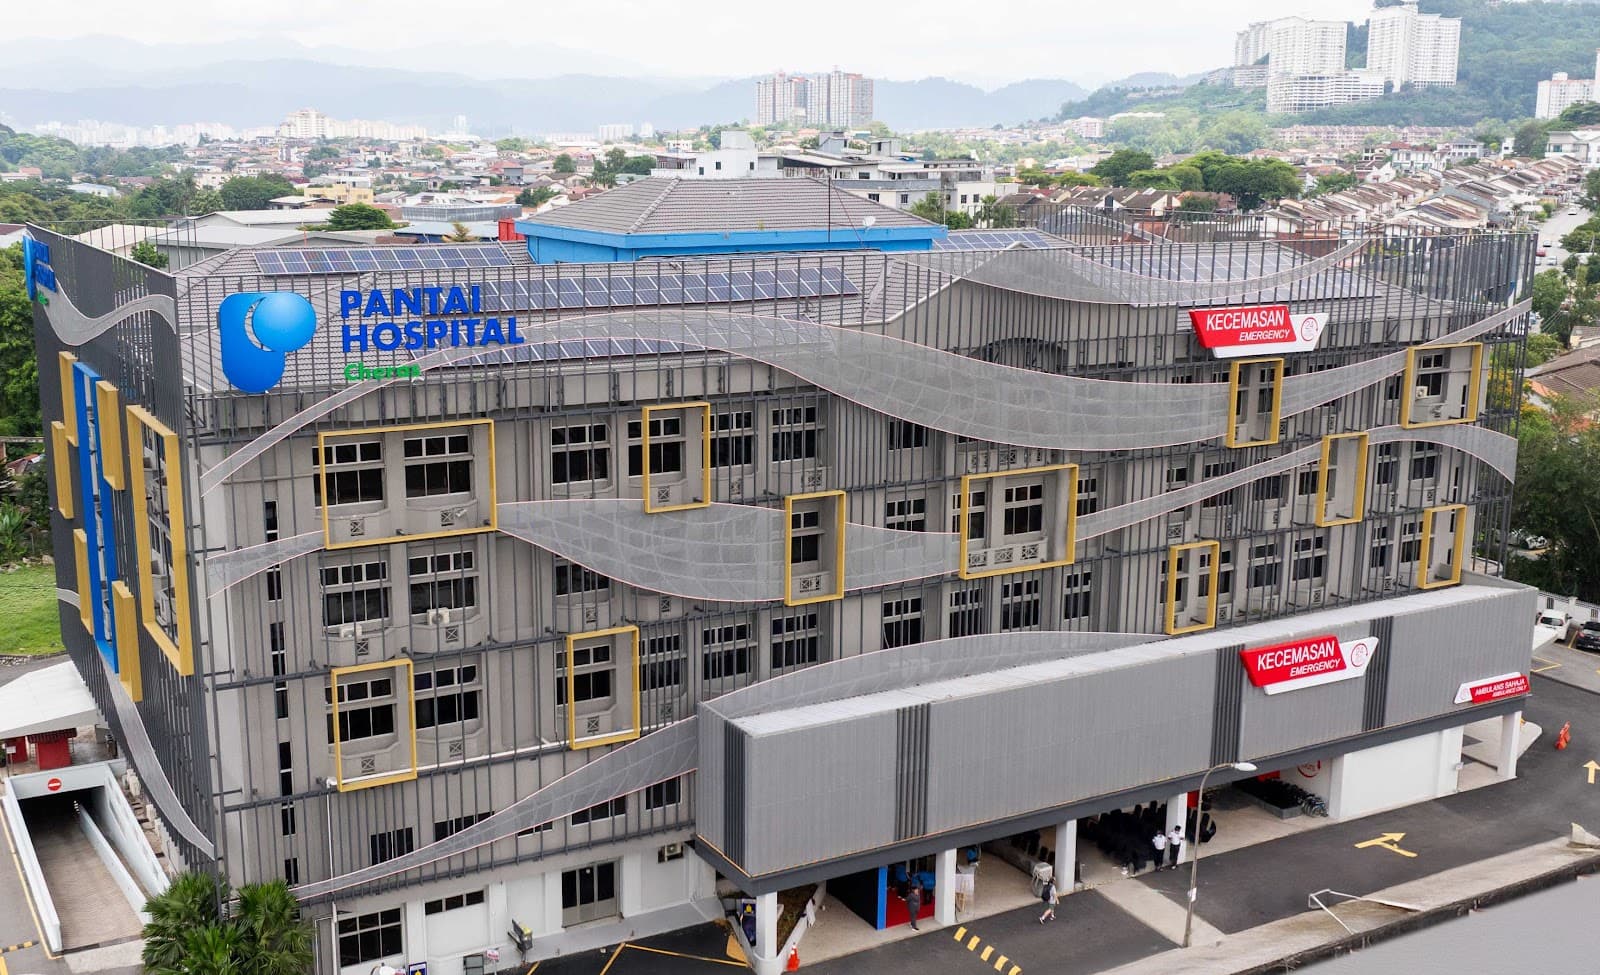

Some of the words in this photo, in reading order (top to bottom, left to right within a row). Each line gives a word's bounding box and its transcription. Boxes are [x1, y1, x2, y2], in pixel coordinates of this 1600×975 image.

[340, 285, 481, 319] PANTAI
[1206, 310, 1285, 331] KECEMASAN
[341, 317, 525, 353] HOSPITAL
[1239, 329, 1290, 341] EMERGENCY
[343, 361, 421, 381] Cheras
[1257, 640, 1335, 671] KECEMASAN
[1290, 658, 1341, 677] EMERGENCY
